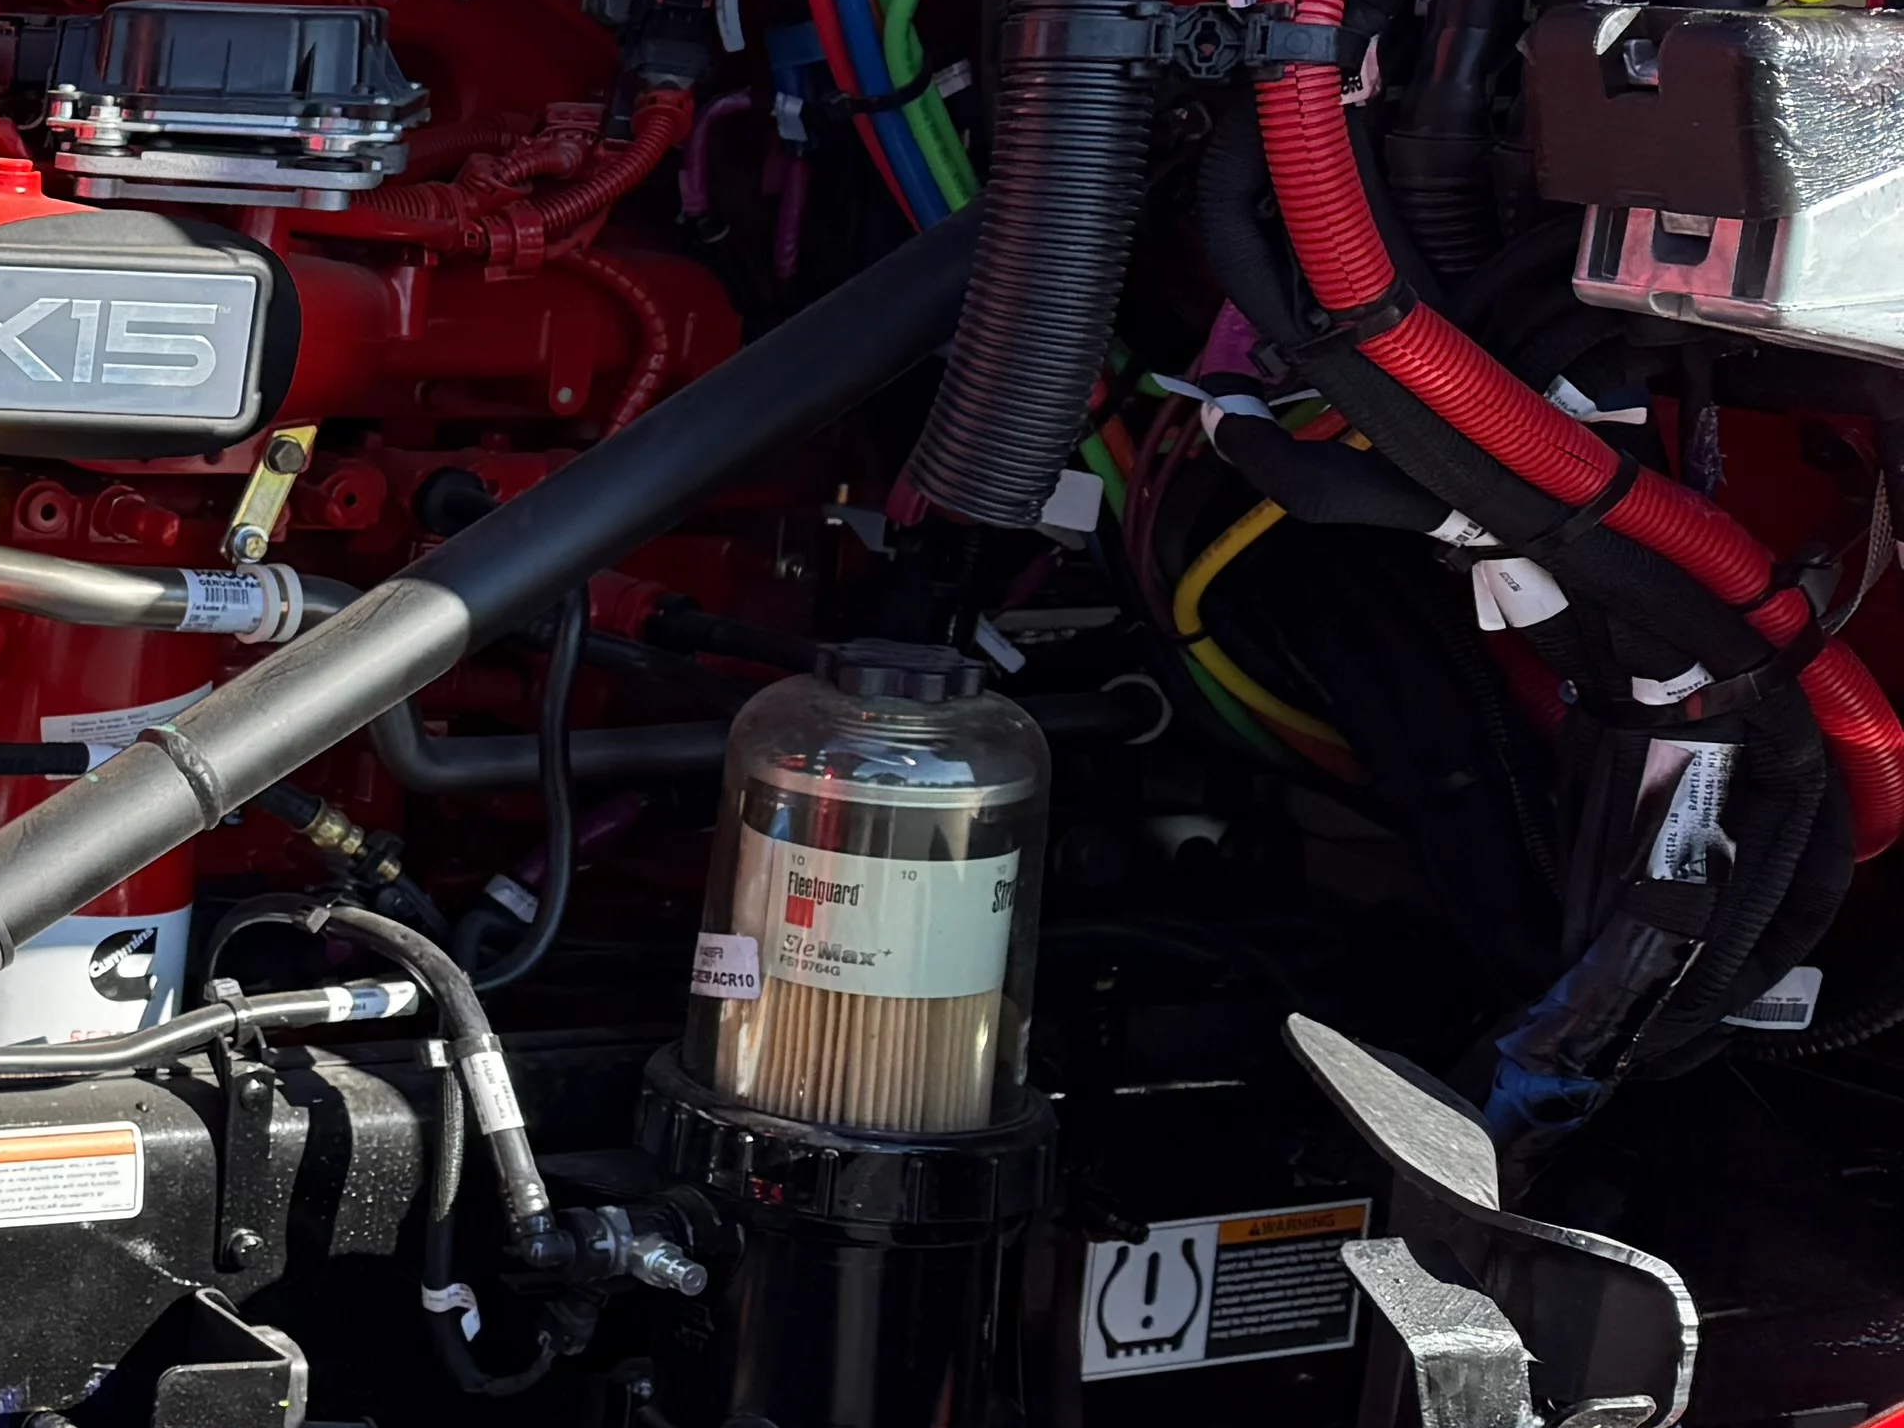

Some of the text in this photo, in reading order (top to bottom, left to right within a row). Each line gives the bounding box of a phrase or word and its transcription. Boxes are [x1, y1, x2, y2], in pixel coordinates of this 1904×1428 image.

[787, 871, 860, 906] Fleetguard
[900, 869, 917, 880] 10
[87, 928, 157, 977] Cummins
